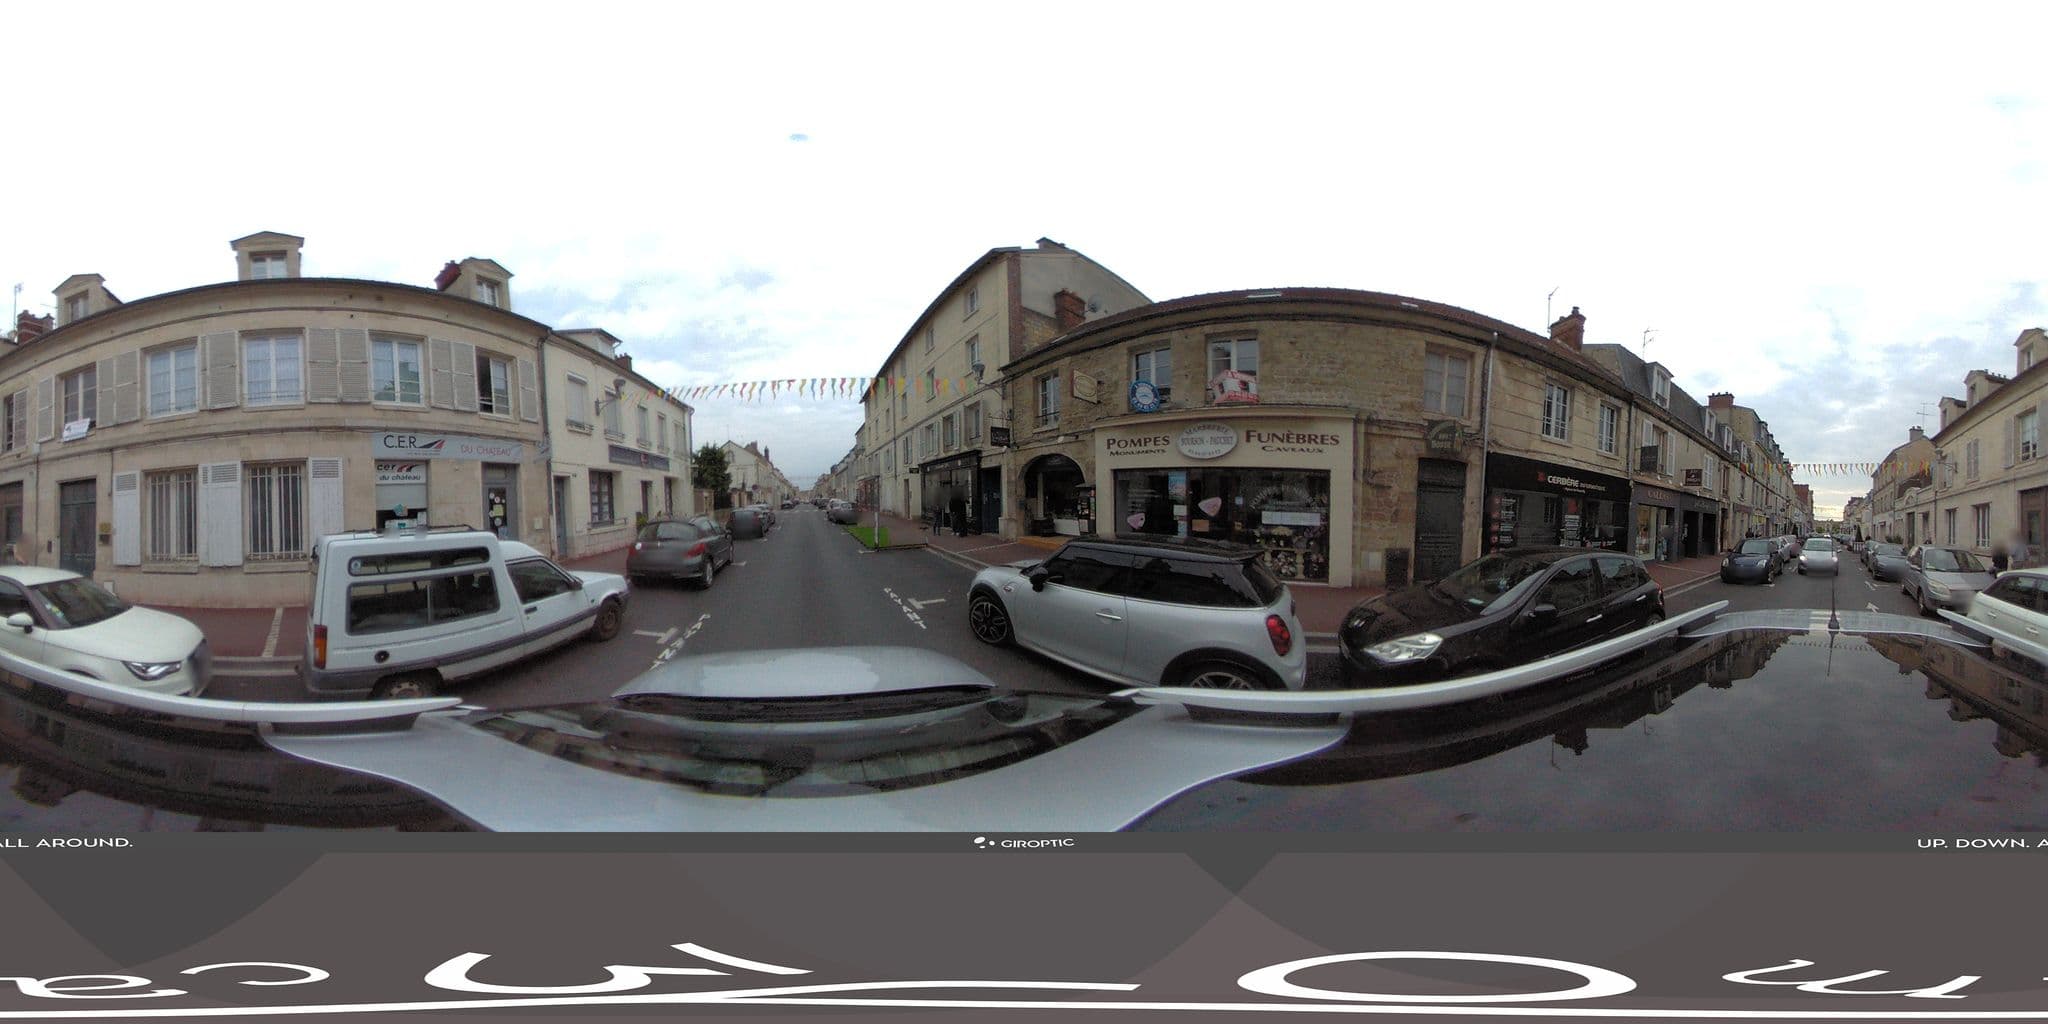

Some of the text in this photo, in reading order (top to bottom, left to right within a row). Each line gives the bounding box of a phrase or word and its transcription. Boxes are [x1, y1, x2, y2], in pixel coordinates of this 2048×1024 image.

[1106, 430, 1341, 450] POMPES FUNÈBRES
[461, 445, 473, 454] DU
[1110, 448, 1167, 457] MONUMENTS
[1262, 445, 1324, 454] CAVEAUX
